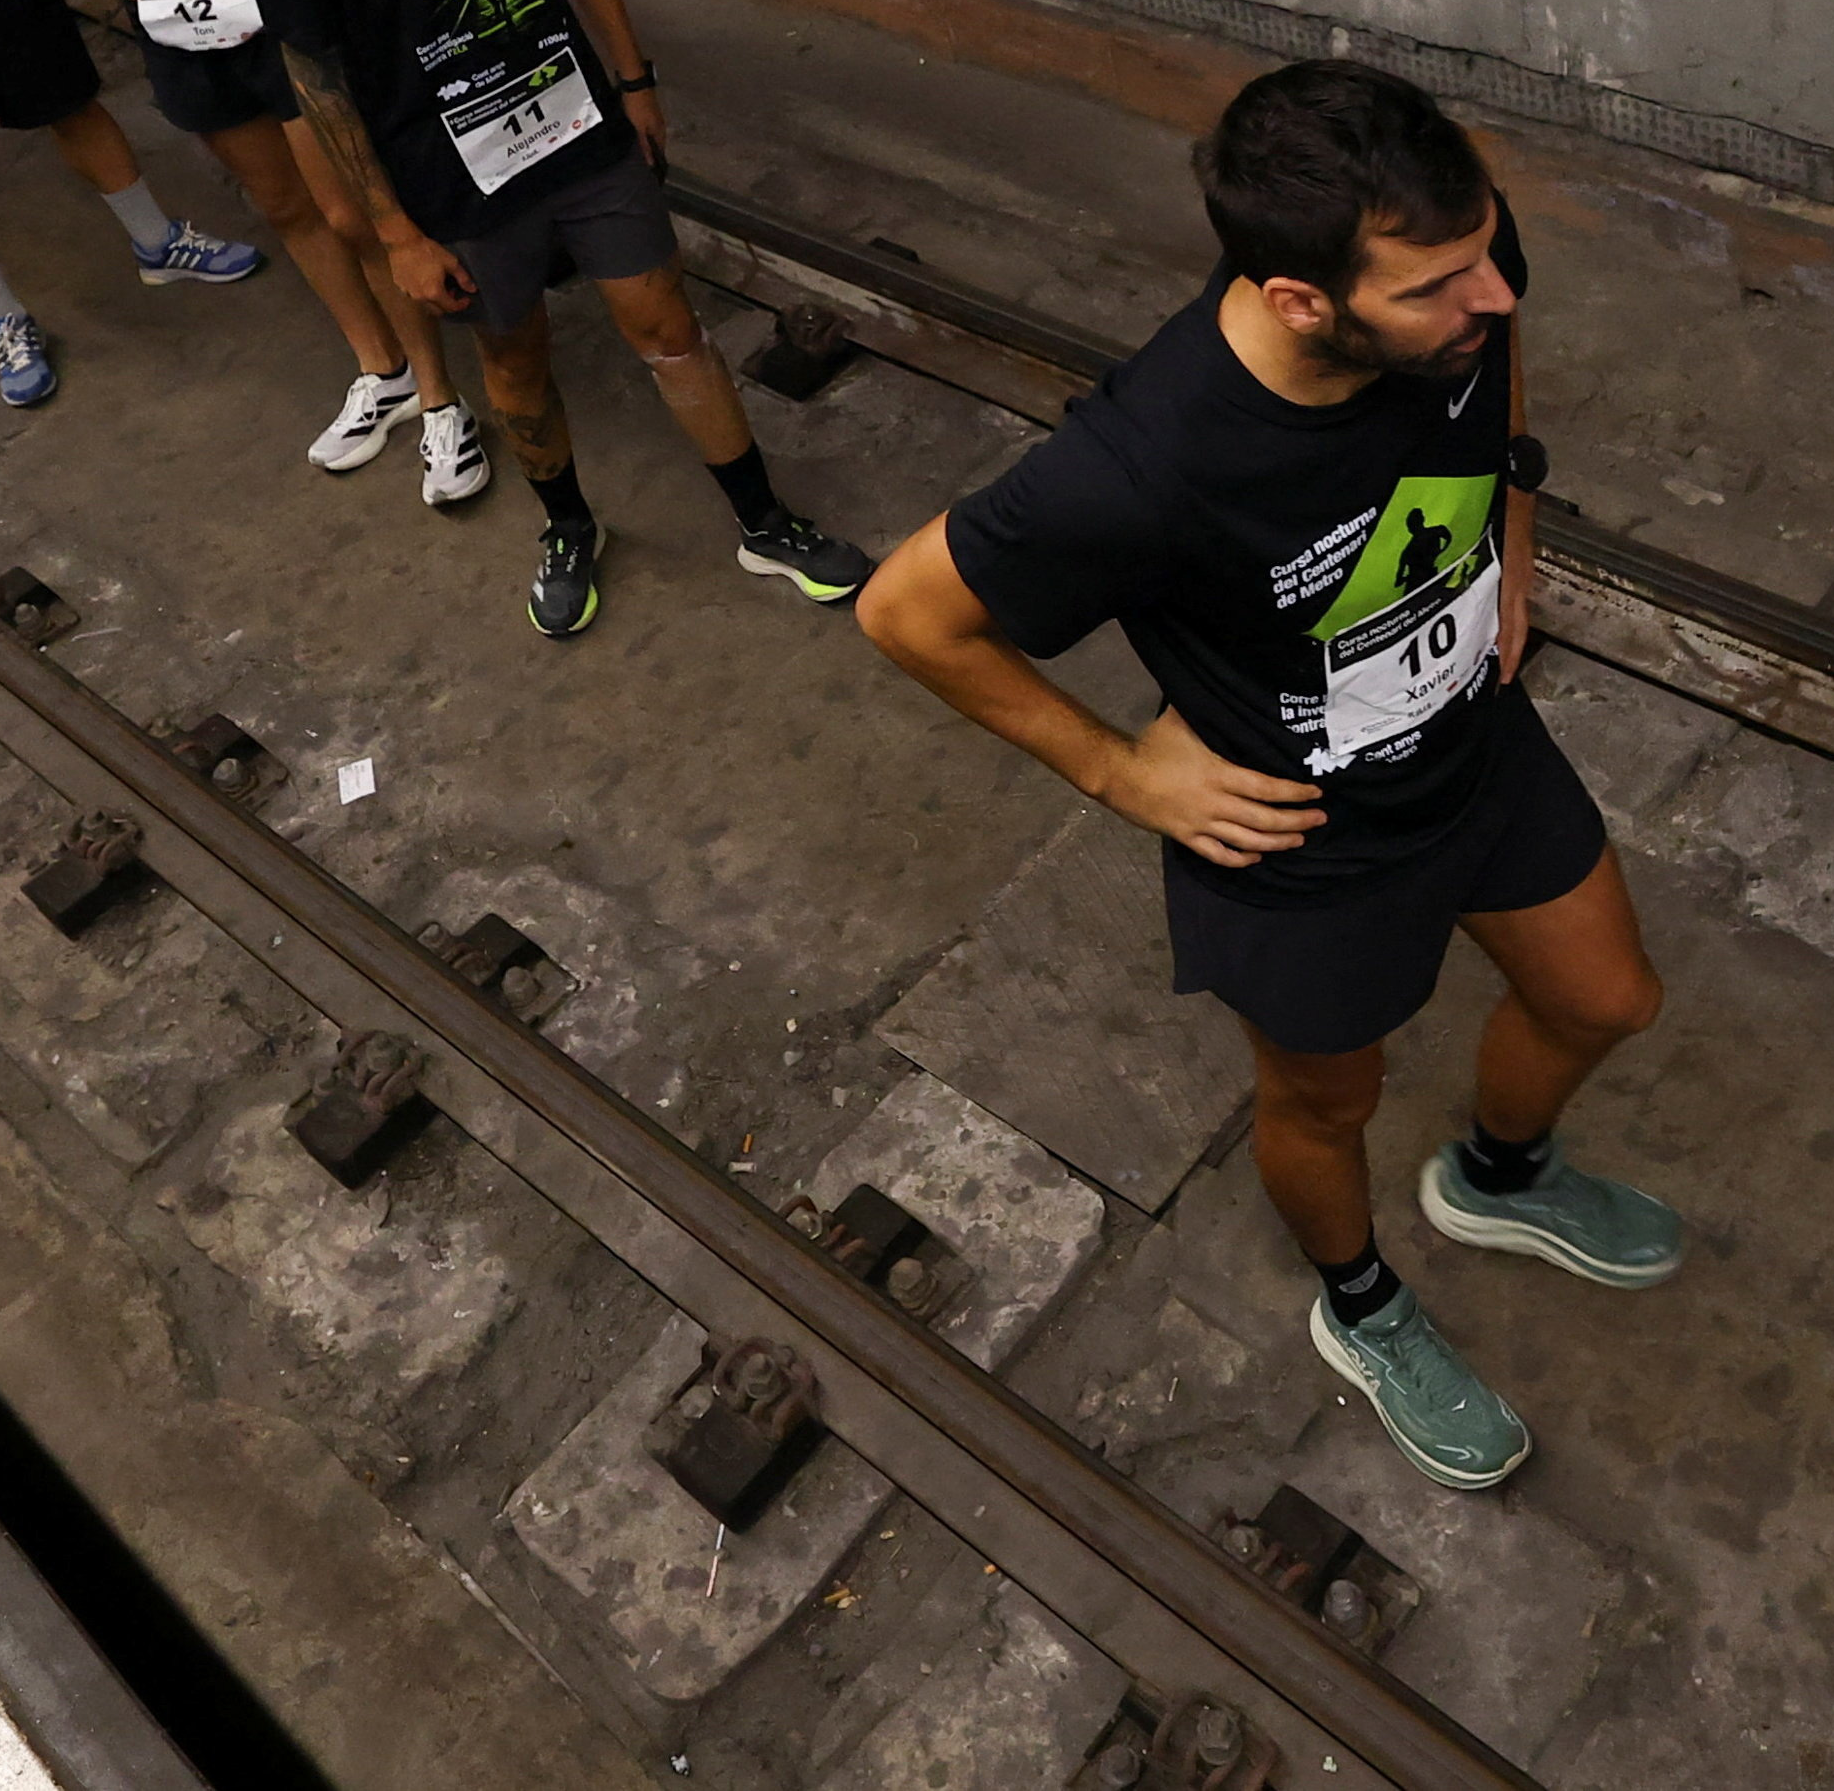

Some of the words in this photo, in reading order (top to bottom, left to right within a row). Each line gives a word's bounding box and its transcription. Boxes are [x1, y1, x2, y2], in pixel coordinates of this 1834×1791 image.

[502, 100, 546, 138] 11
[506, 120, 562, 159] Alejandro
[1269, 548, 1314, 579] Cursa
[1312, 506, 1378, 556] nocturna
[1273, 574, 1299, 594] del
[1301, 529, 1368, 584] Centenari
[1276, 592, 1297, 610] de
[1299, 567, 1344, 599] Metro
[1337, 629, 1369, 650] Cursa
[1398, 613, 1457, 679] 10
[1279, 692, 1320, 706] Corre
[1405, 662, 1457, 704] Xavier
[1280, 706, 1296, 721] la
[1365, 742, 1395, 762] Cent
[1393, 730, 1423, 752] anys
